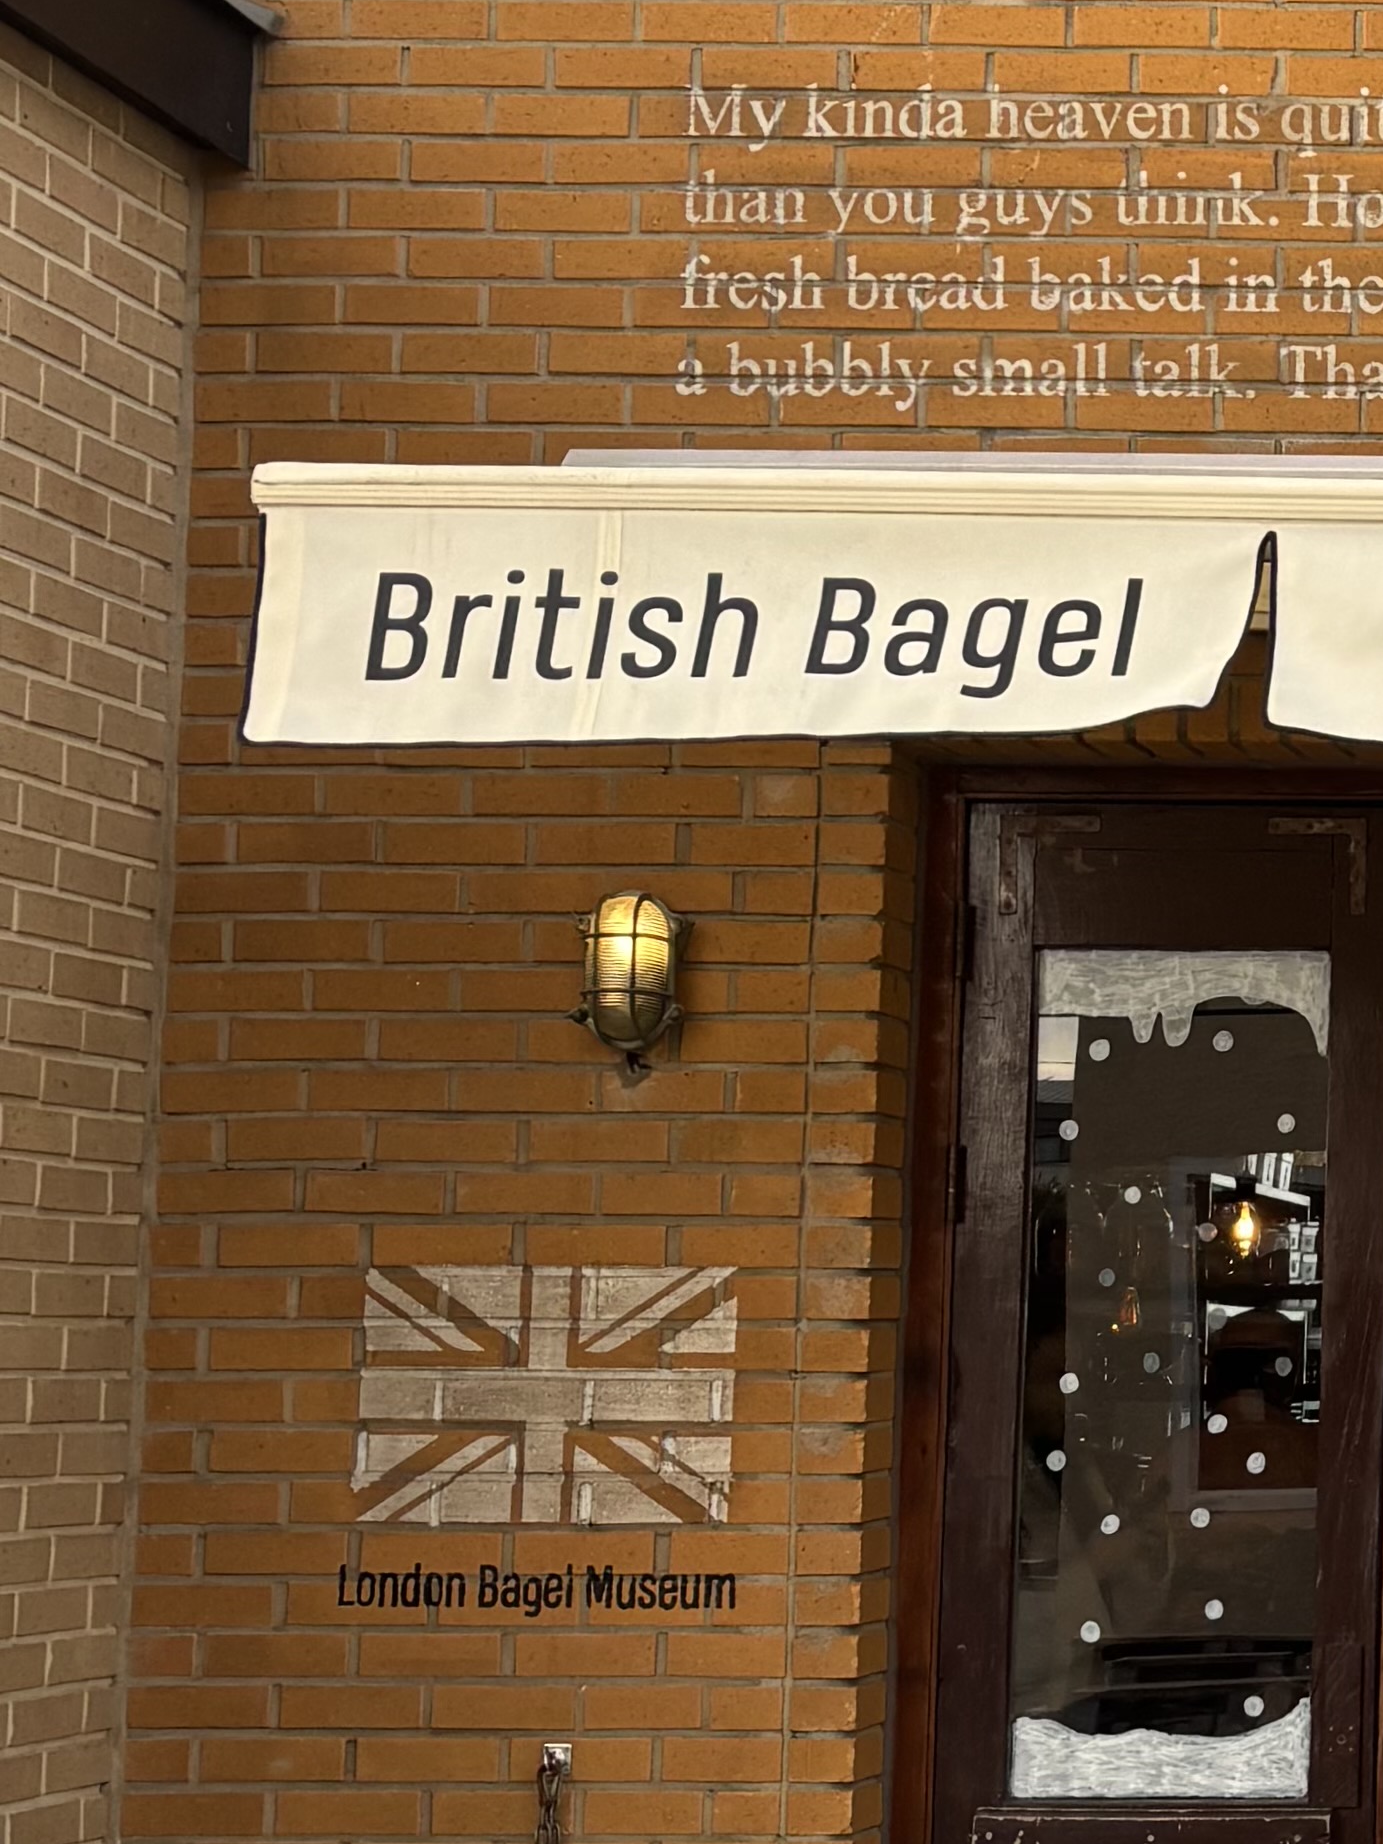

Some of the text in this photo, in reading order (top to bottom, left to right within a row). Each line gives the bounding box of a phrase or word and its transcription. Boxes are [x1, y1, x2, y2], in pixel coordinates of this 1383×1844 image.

[684, 84, 786, 152] My
[801, 83, 969, 140] kinda
[984, 84, 1196, 141] heaven
[1215, 84, 1260, 142] is
[684, 170, 805, 225] than
[828, 188, 936, 236] you
[956, 187, 1094, 240] guys
[1116, 172, 1280, 226] think.
[680, 255, 825, 310] fresh
[846, 255, 1009, 311] bread
[1026, 257, 1203, 313] baked
[1222, 257, 1280, 313] in
[674, 356, 709, 397] a
[726, 342, 928, 412] bubbly
[951, 342, 1111, 398] small
[1132, 343, 1257, 400] talk.
[363, 569, 1143, 699] British Bagel
[337, 1563, 736, 1617] London Bagel Museum
